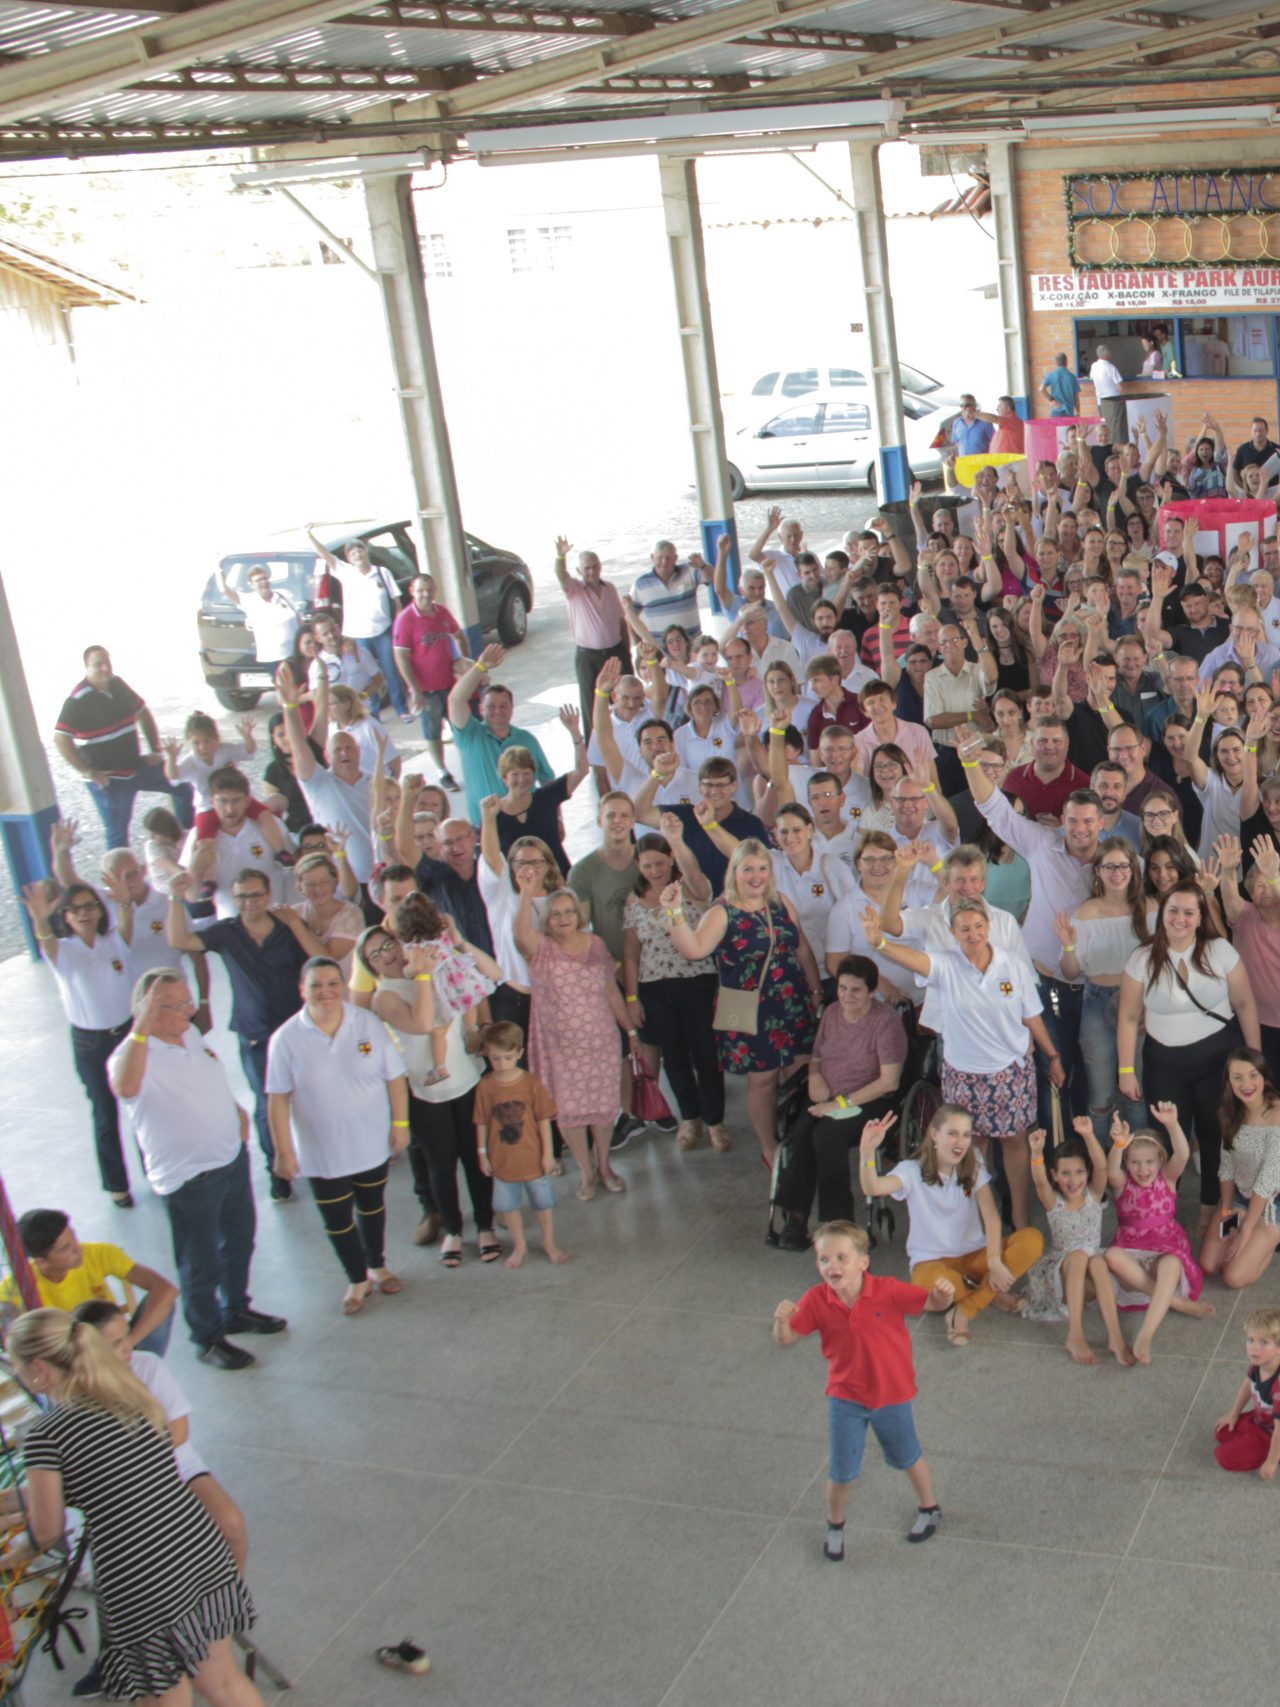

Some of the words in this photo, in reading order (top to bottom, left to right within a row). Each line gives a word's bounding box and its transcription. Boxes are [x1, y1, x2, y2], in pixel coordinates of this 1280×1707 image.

[1038, 271, 1178, 292] RESTAURANTE
[1183, 271, 1237, 288] PARK
[1107, 291, 1155, 299] X-BACON
[1161, 289, 1217, 298] X-FRANGO
